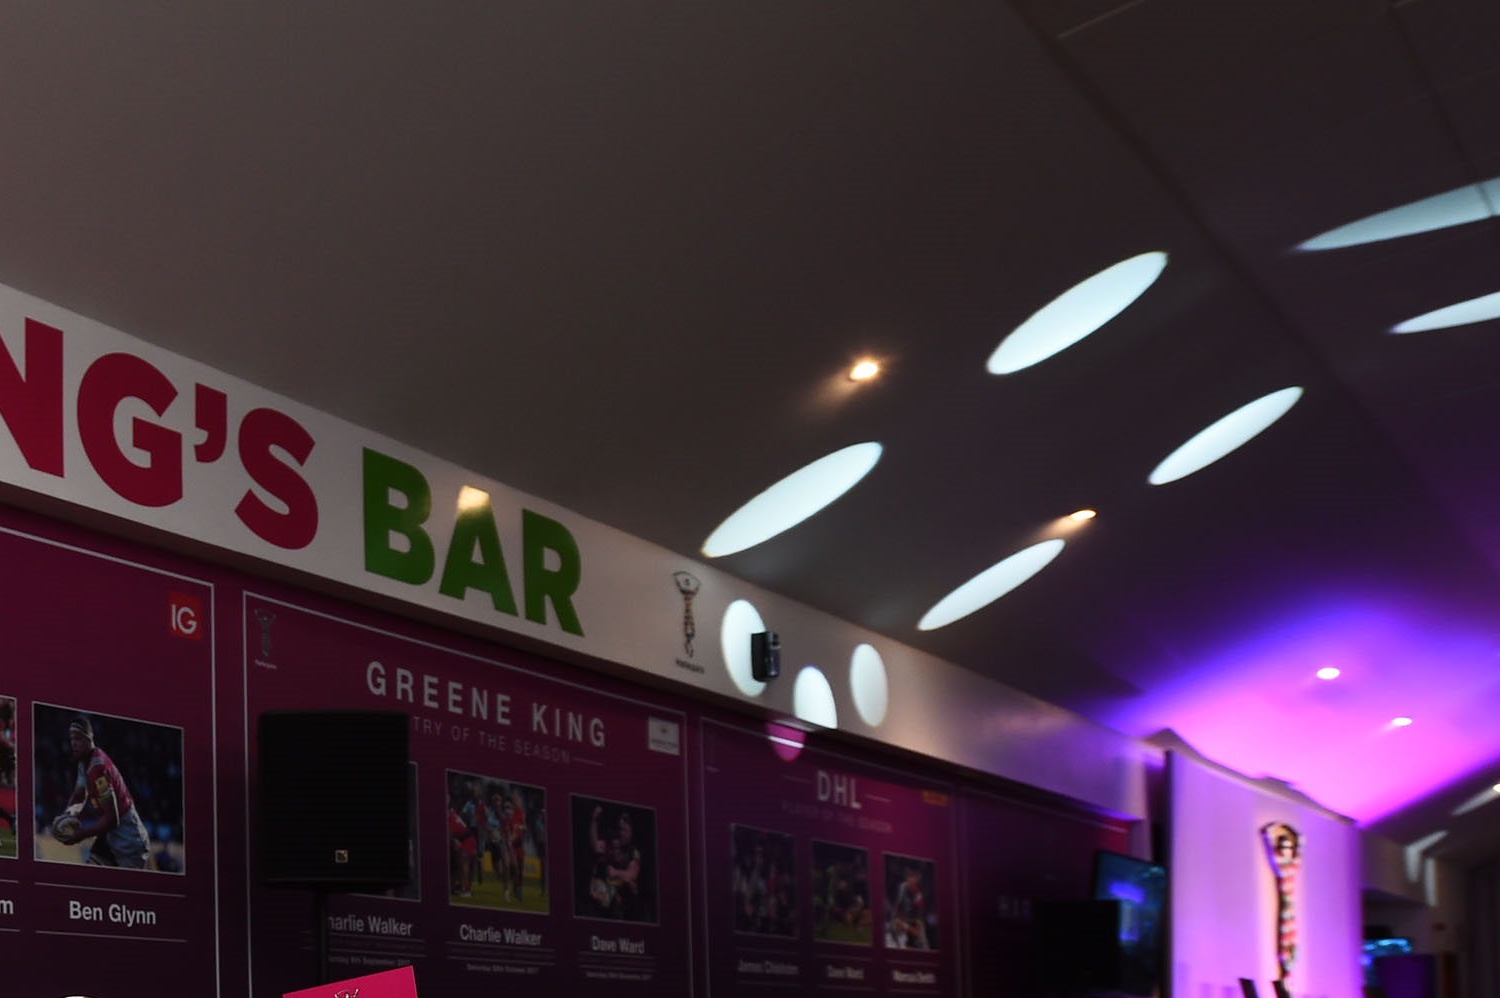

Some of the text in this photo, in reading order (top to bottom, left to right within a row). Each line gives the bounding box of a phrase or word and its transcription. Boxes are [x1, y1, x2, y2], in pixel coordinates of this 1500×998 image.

[362, 444, 587, 639] BAR
[170, 603, 198, 635] IG
[366, 660, 607, 747] GREENE KING
[413, 715, 572, 765] TRY OF THE SEASON
[816, 769, 862, 810] DHL
[69, 901, 157, 928] Ben Glynn
[327, 914, 413, 937] harlie Walker
[460, 923, 543, 947] Charlie Walker
